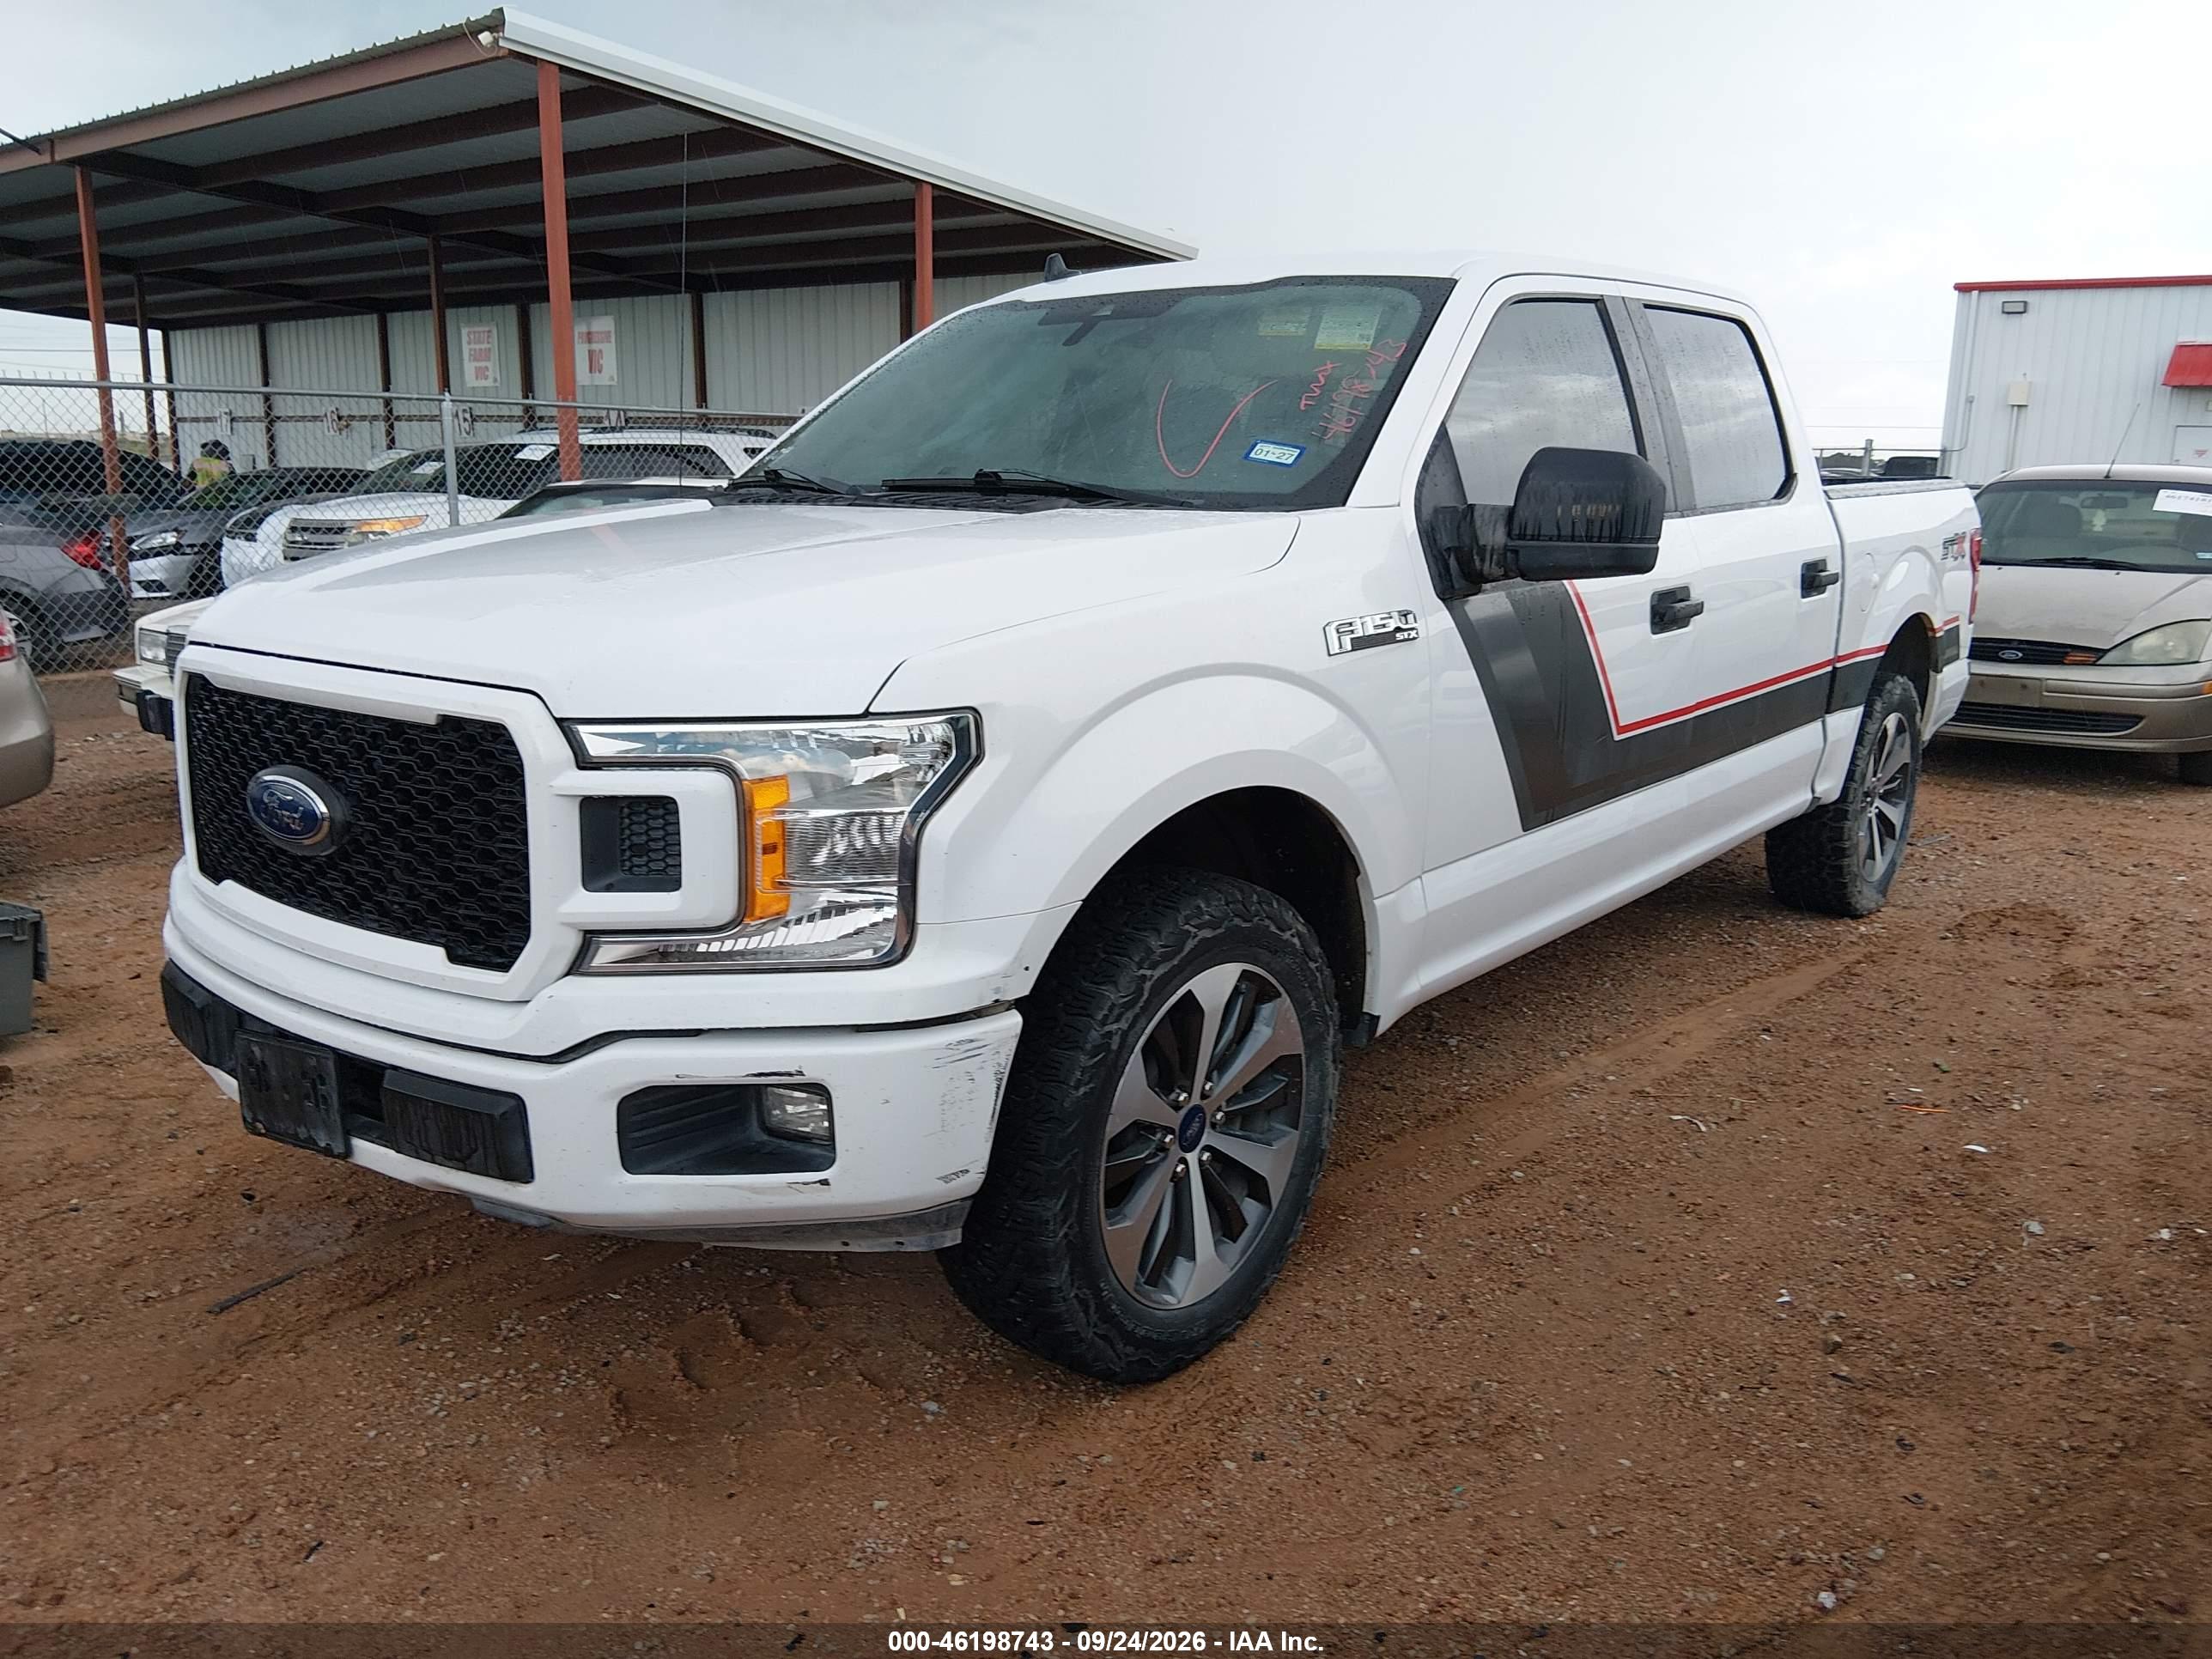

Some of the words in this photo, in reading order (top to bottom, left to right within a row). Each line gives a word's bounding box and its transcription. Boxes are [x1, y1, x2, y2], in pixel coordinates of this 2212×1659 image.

[466, 330, 492, 345] STATE
[587, 349, 604, 374] VIC
[474, 366, 489, 381] VIC
[453, 407, 471, 437] 15
[1254, 447, 1295, 461] 01-27
[1941, 531, 1966, 562] STX
[1395, 629, 1419, 641] STX
